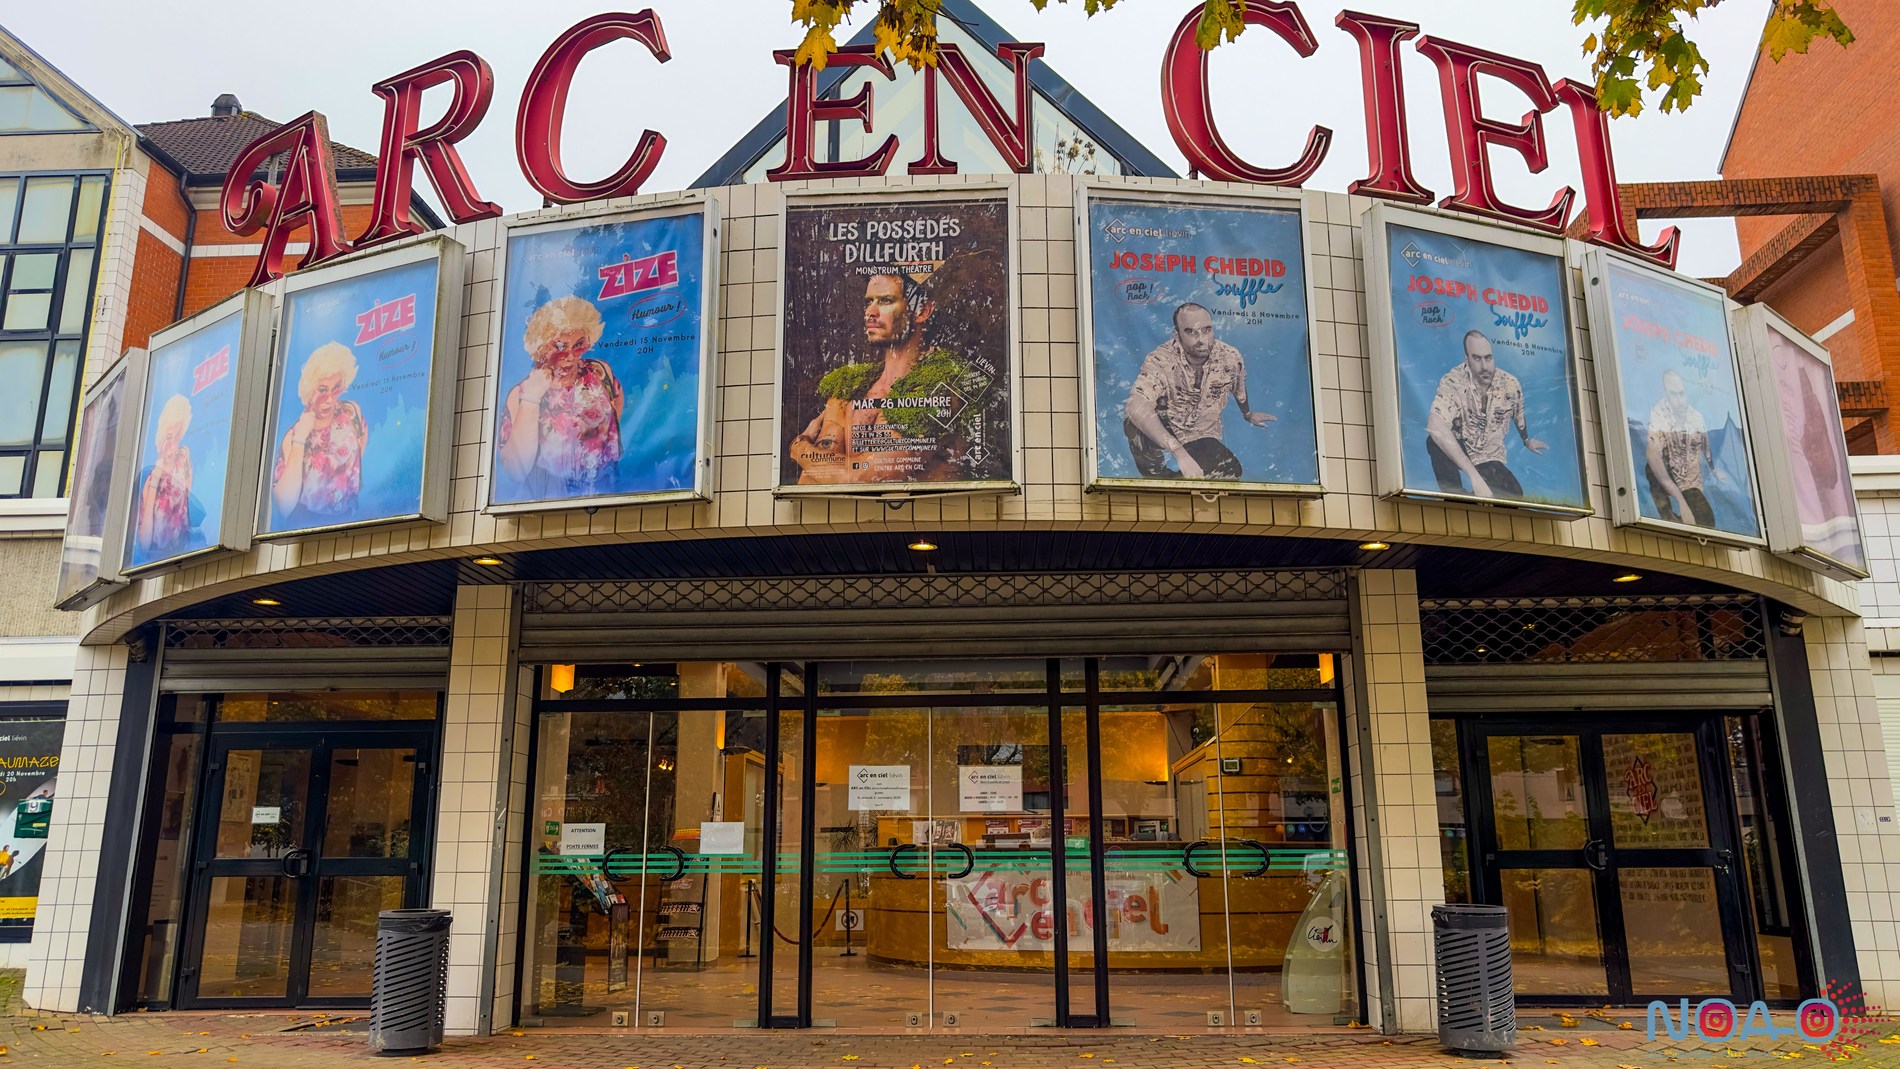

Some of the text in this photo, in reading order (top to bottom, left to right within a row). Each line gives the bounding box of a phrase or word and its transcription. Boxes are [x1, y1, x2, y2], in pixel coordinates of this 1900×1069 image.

[220, 0, 1681, 287] ARC EN CIEL
[829, 216, 961, 241] LES POSSÉDÉS
[1110, 226, 1127, 235] arc
[1129, 228, 1142, 236] en
[1144, 228, 1162, 238] ciel
[845, 241, 944, 263] D'ILLFURTH
[1405, 250, 1421, 259] arc
[1422, 253, 1433, 261] en
[1434, 255, 1448, 266] ciel
[856, 265, 898, 275] MONSTRUM
[1110, 250, 1286, 277] JOSEPH CHEDID
[1125, 282, 1147, 292] pop
[1407, 274, 1549, 314] JOSEPH CHEDID
[1127, 292, 1150, 300] Rock
[631, 303, 674, 321] Humour
[1211, 308, 1248, 317] Vendredi
[1259, 311, 1300, 320] Novembre
[1421, 305, 1441, 317] pop
[1246, 318, 1263, 326] 20H
[598, 334, 696, 349] Vendredi 15 Novembre
[1491, 338, 1523, 348] Vendredi
[1532, 343, 1563, 354] Novembre
[637, 346, 654, 354] 20H
[1521, 349, 1536, 357] 20H
[351, 381, 381, 391] Vendredi
[392, 371, 425, 382] Novembre
[852, 396, 951, 410] MAR. 26 NOVEMBRE
[936, 409, 951, 418] 20H
[973, 413, 982, 460] arc en ciel
[800, 451, 836, 459] culture
[1625, 763, 1653, 788] ARC
[1632, 792, 1658, 815] CIEL
